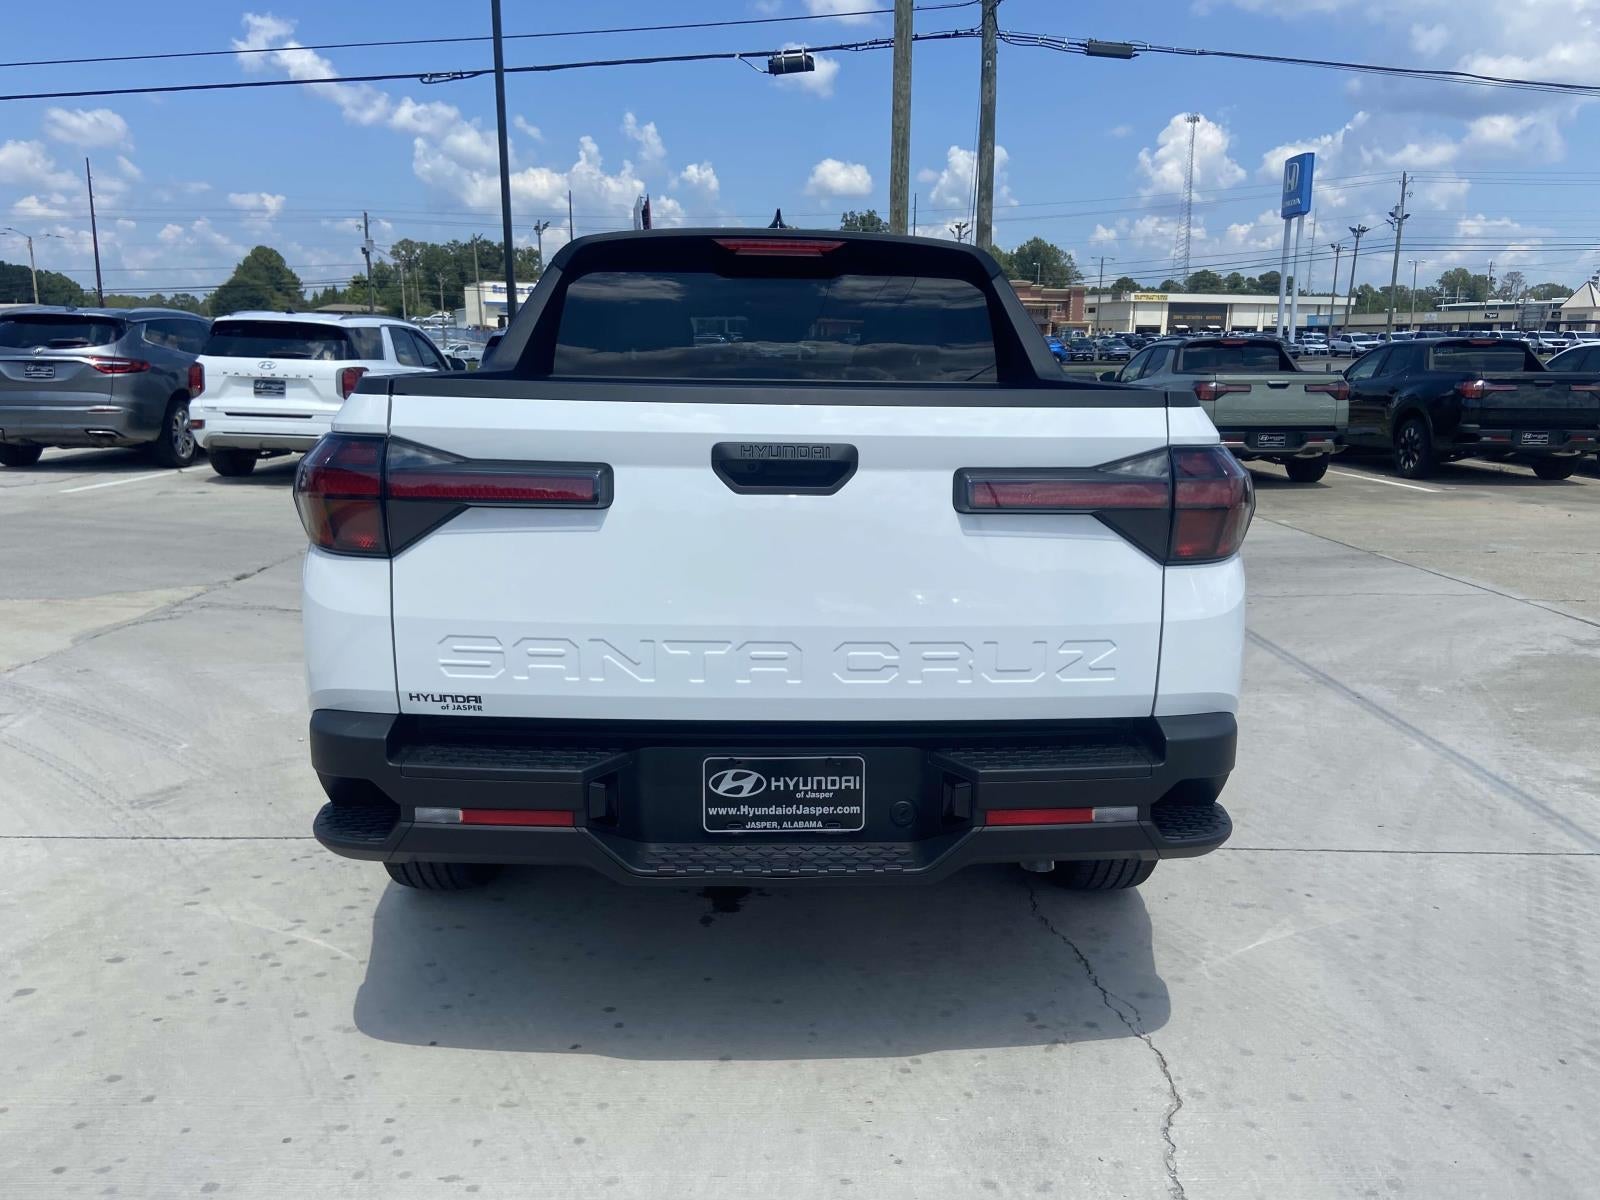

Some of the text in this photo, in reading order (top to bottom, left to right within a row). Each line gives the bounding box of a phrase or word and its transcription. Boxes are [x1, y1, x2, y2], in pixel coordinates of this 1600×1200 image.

[740, 445, 832, 459] HYUNDAI
[437, 634, 1119, 684] SANTA CRUZ
[408, 692, 483, 704] HYUNDAI
[440, 703, 484, 712] of JASPER
[770, 775, 861, 791] HYUNDAI
[795, 791, 834, 799] of Jasper
[708, 804, 861, 816] www.HyundaiofJasper.com
[745, 820, 823, 829] JASPER, ALABAMA
